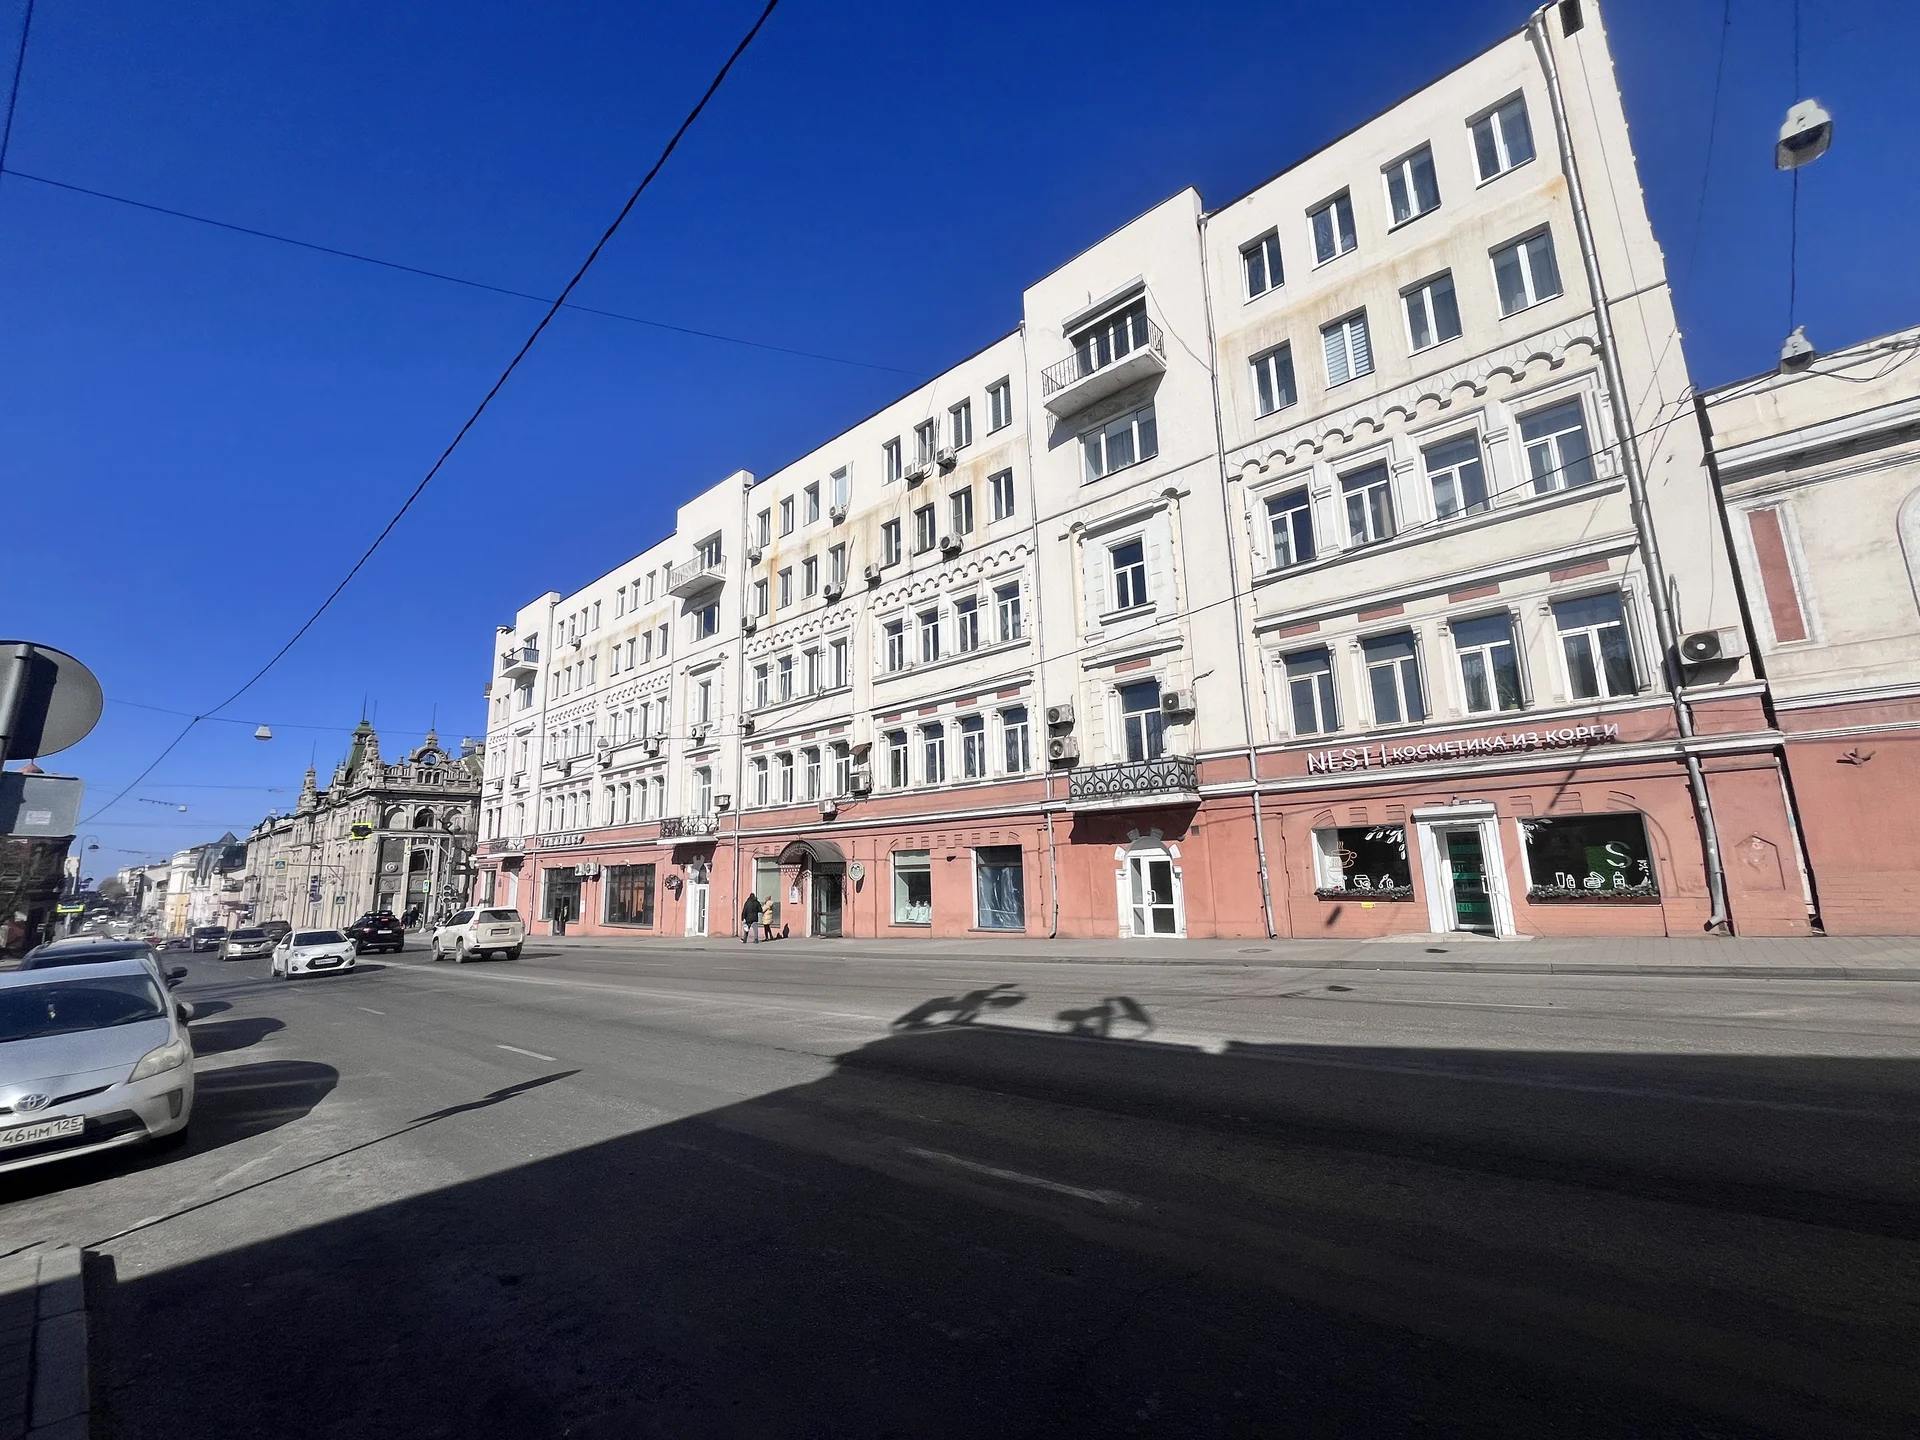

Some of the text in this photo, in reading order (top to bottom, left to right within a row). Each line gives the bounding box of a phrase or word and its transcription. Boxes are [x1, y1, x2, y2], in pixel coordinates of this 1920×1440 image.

[1392, 723, 1619, 759] КОСМЕТИКА ИЗ КОРЕИ
[1308, 746, 1373, 772] NEST
[0, 1118, 79, 1143] 46НМ 125
